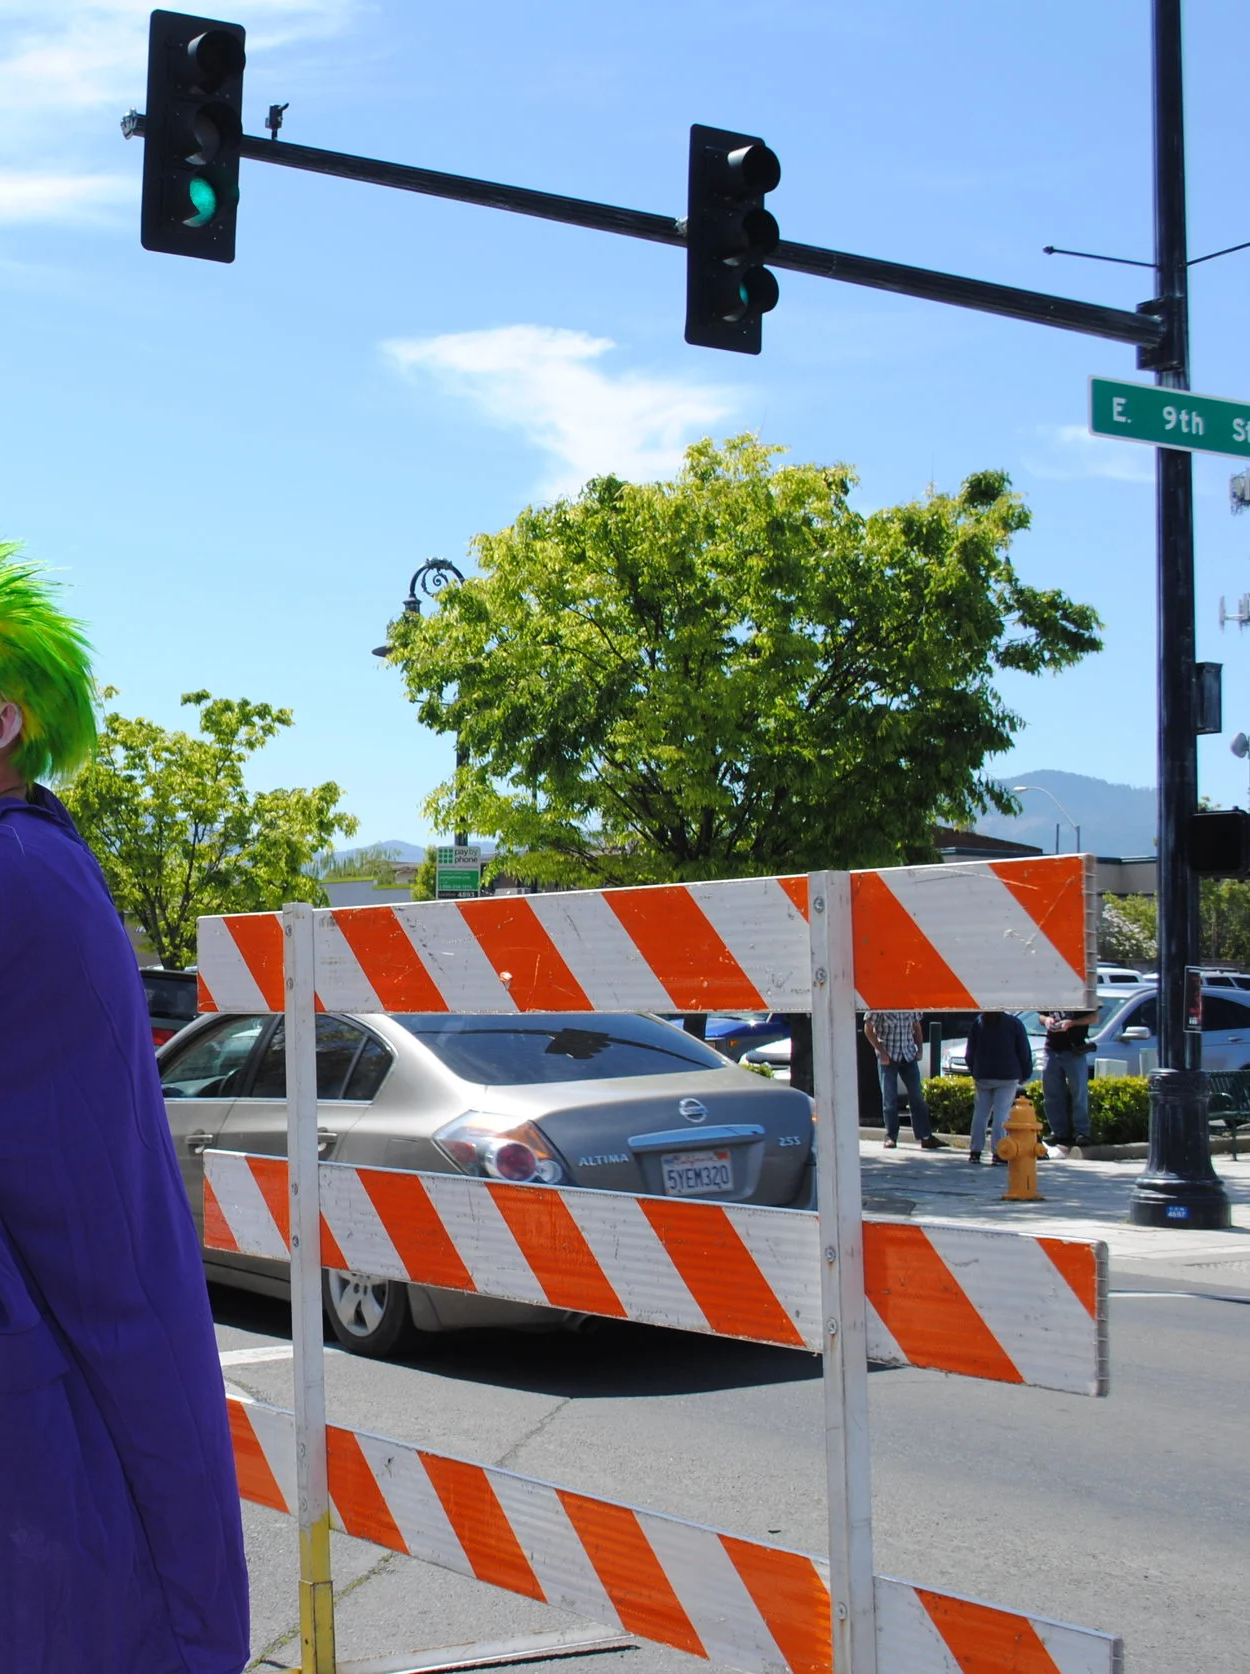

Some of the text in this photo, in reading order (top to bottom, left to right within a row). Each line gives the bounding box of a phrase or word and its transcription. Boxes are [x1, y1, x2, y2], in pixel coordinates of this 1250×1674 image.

[1112, 397, 1132, 423] E.
[1162, 406, 1205, 436] 9th
[455, 856, 478, 864] phone
[578, 1153, 630, 1167] ALTIMA
[667, 1164, 730, 1190] 5YEM320
